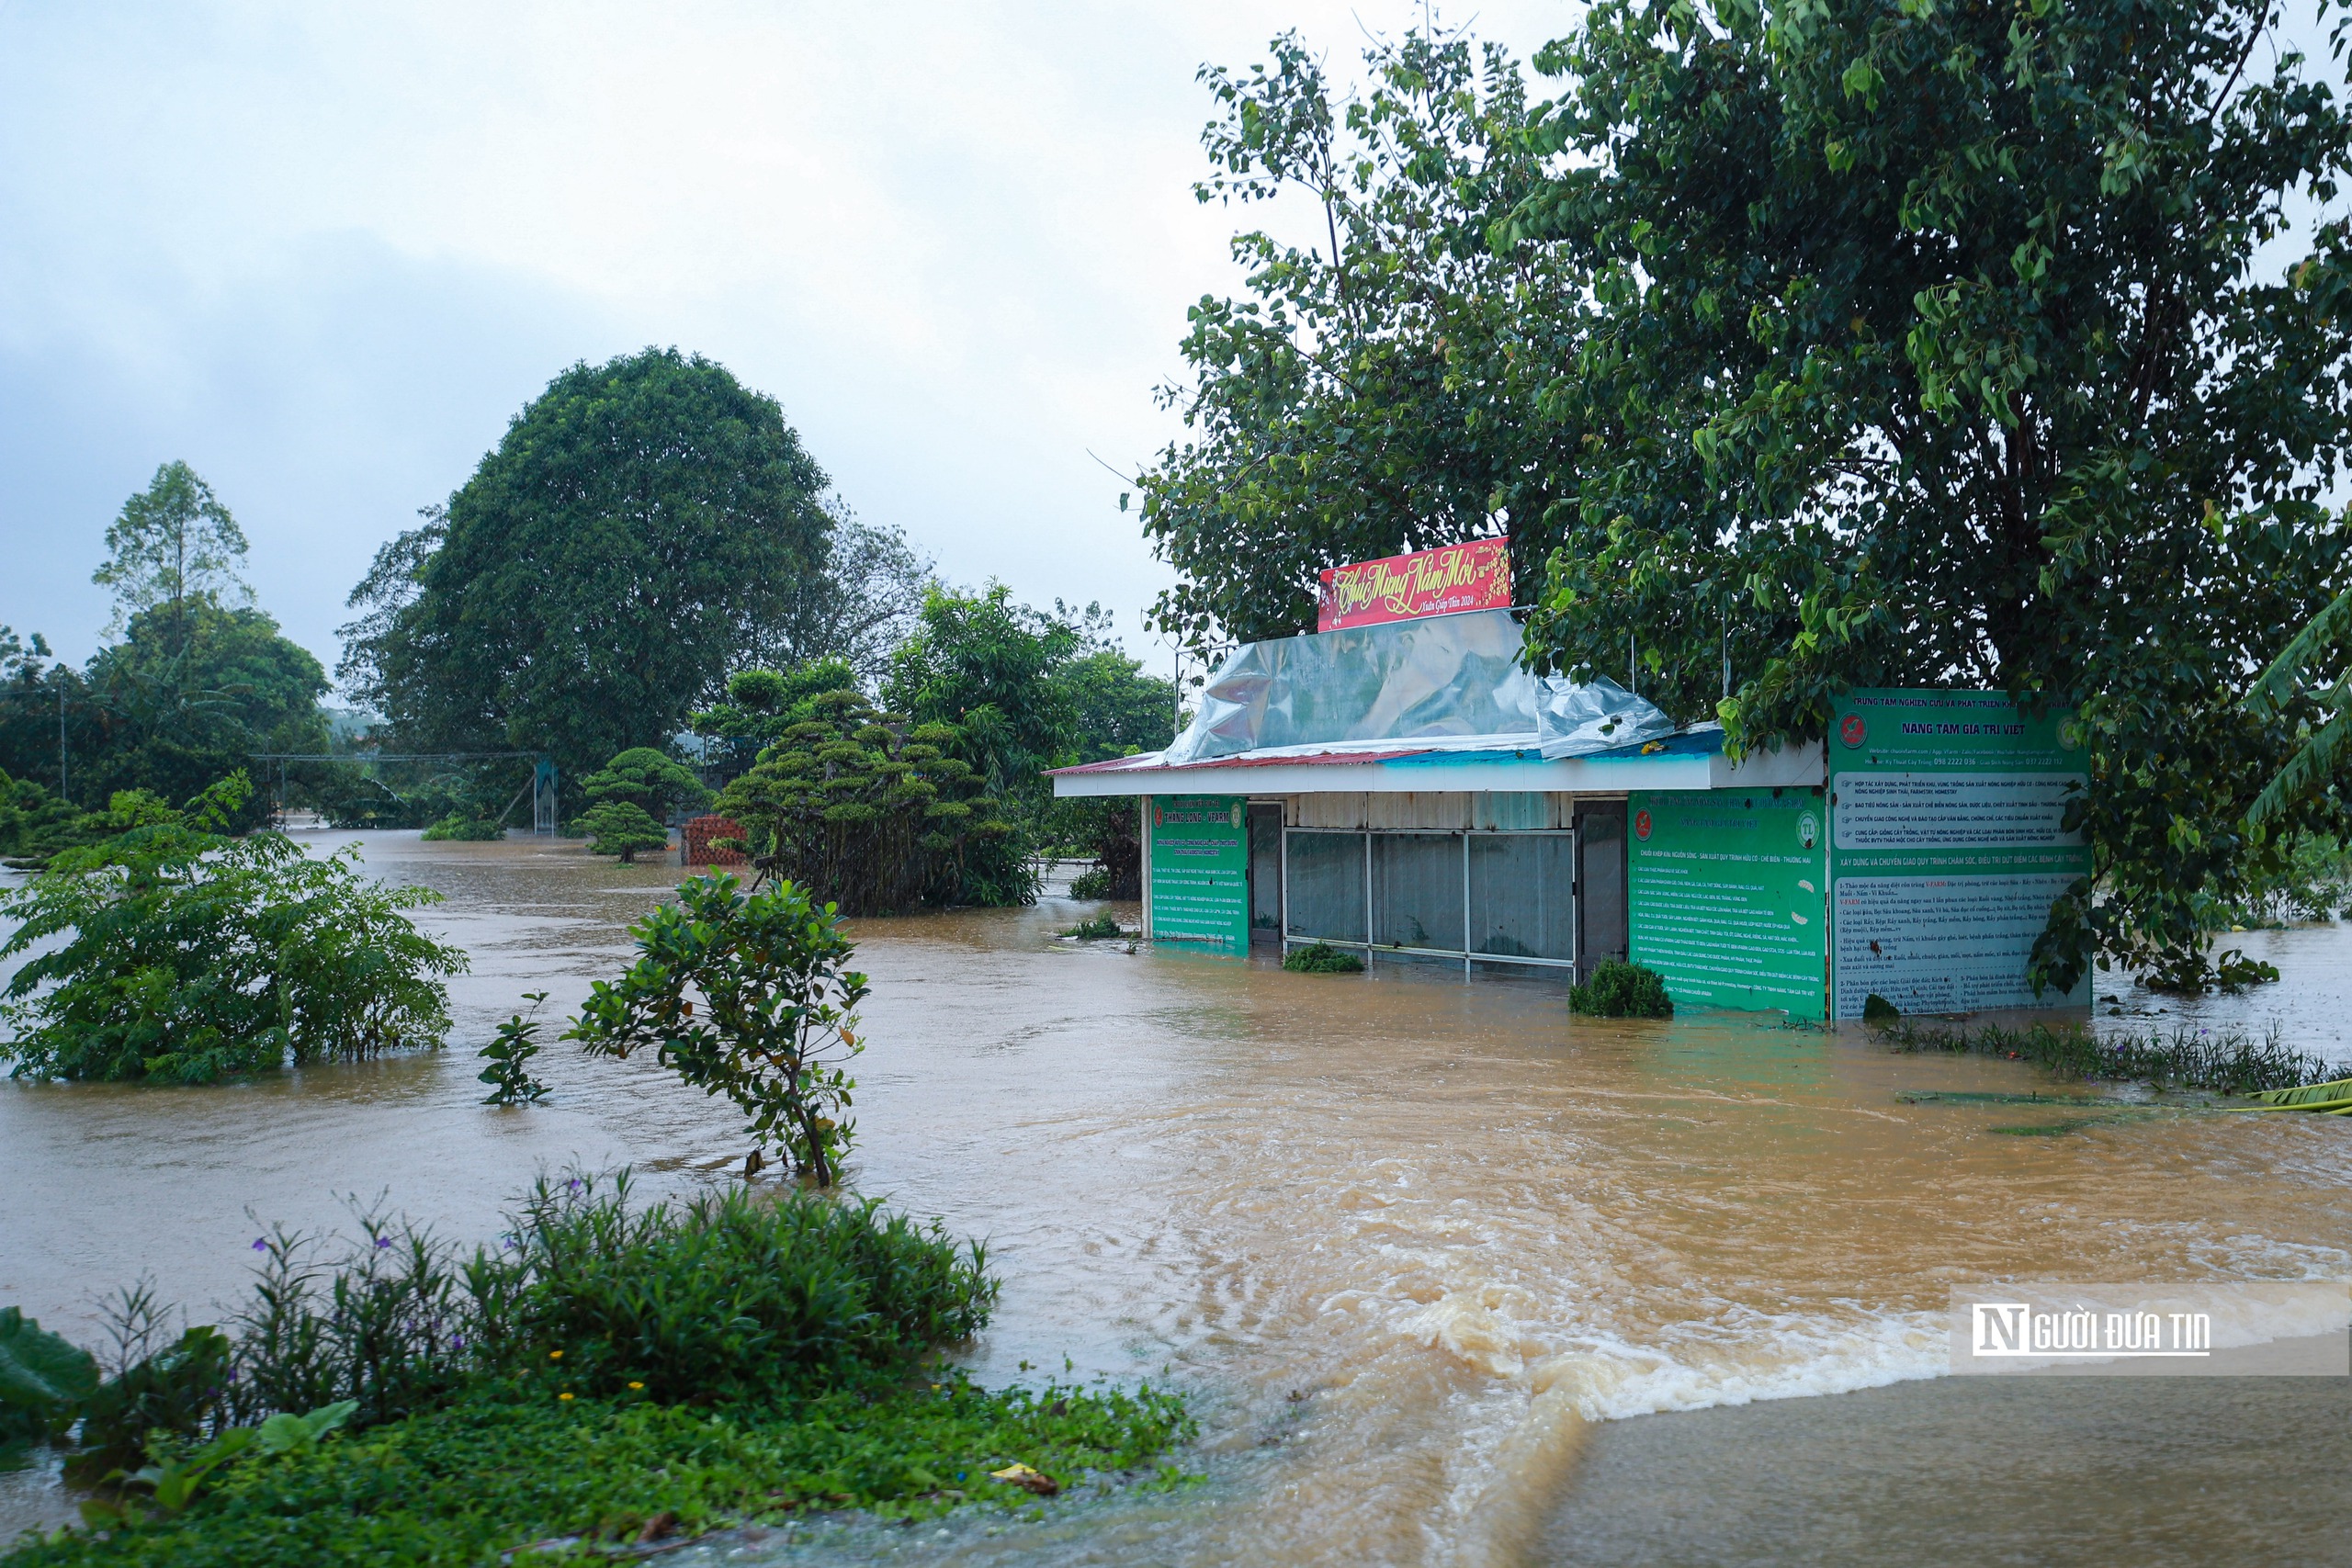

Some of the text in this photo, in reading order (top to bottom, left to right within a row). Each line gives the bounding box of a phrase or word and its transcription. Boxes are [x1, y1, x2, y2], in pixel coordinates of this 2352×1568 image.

[1336, 548, 1476, 615] Chúc Mừng Năm Mới
[1420, 595, 1474, 614] Xuân Giáp Thìn 2024
[1853, 697, 1878, 706] TRUNG
[1934, 757, 1945, 766] 098
[1947, 757, 1962, 766] 2222
[1963, 757, 1976, 766] 036
[2026, 757, 2036, 766] 037
[2038, 758, 2052, 766] 2222
[2053, 758, 2063, 766] 112
[1185, 812, 1202, 824] LONG
[1207, 811, 1229, 824] VFARM
[1802, 823, 1814, 835] TL
